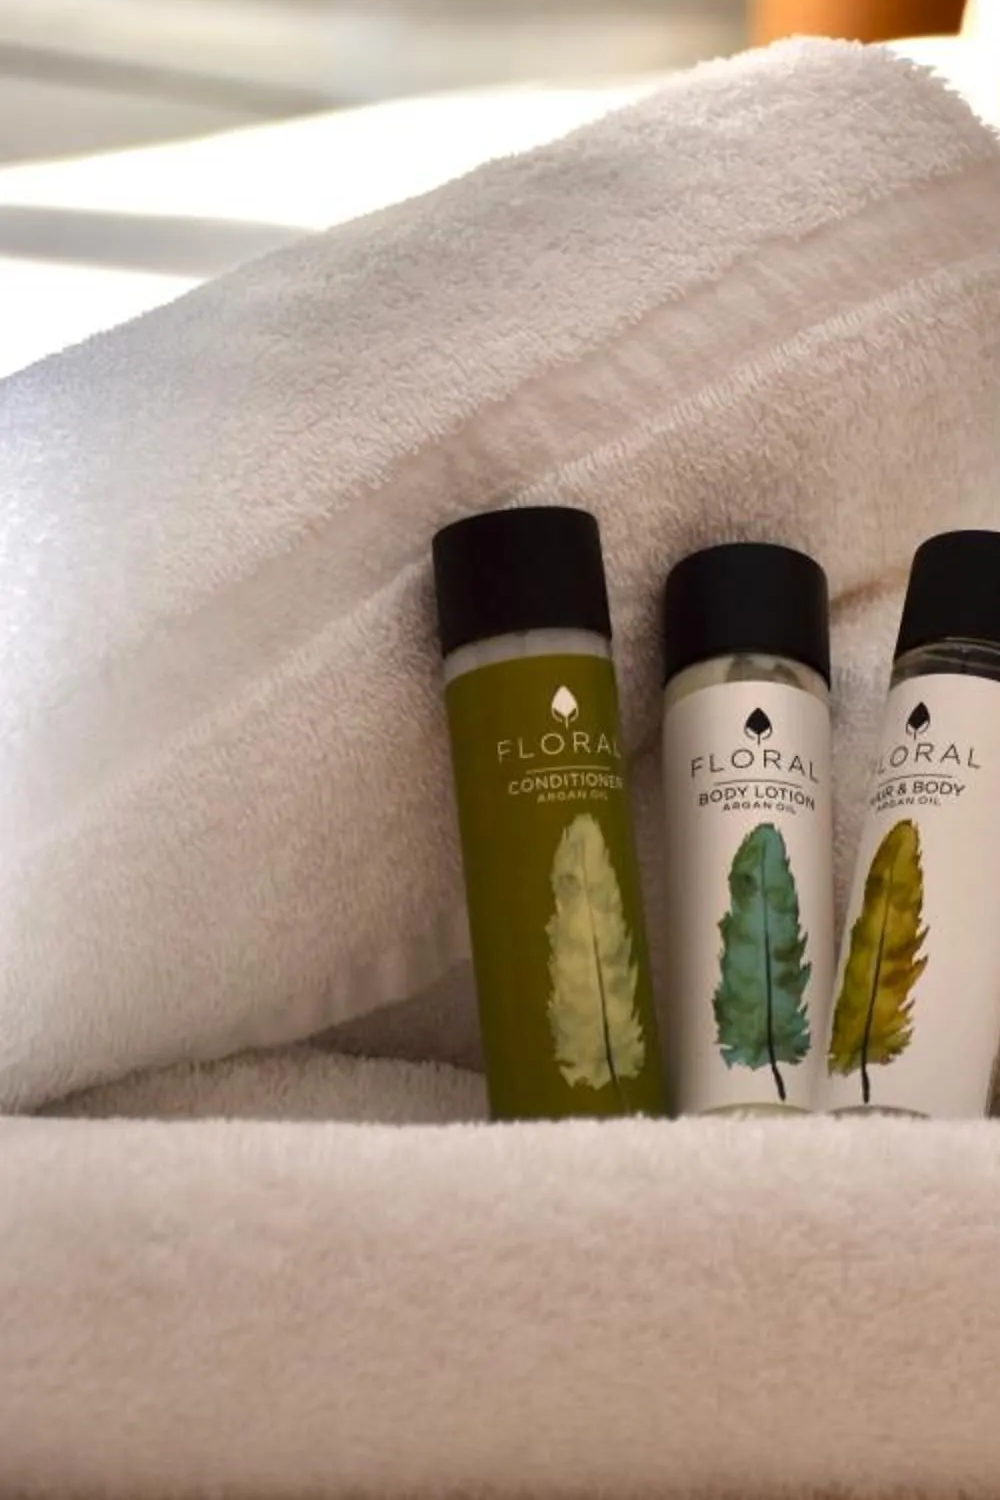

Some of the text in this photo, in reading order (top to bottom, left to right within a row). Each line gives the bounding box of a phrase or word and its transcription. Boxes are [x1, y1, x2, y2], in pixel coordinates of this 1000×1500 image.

[497, 731, 622, 763] FLORAL
[877, 743, 981, 773] LORAL
[691, 749, 819, 784] FLORAL
[699, 786, 815, 811] BODY LOTION
[897, 783, 907, 795] &
[913, 781, 966, 797] BODY
[918, 796, 941, 805] OIL
[723, 801, 771, 811] ARGAN
